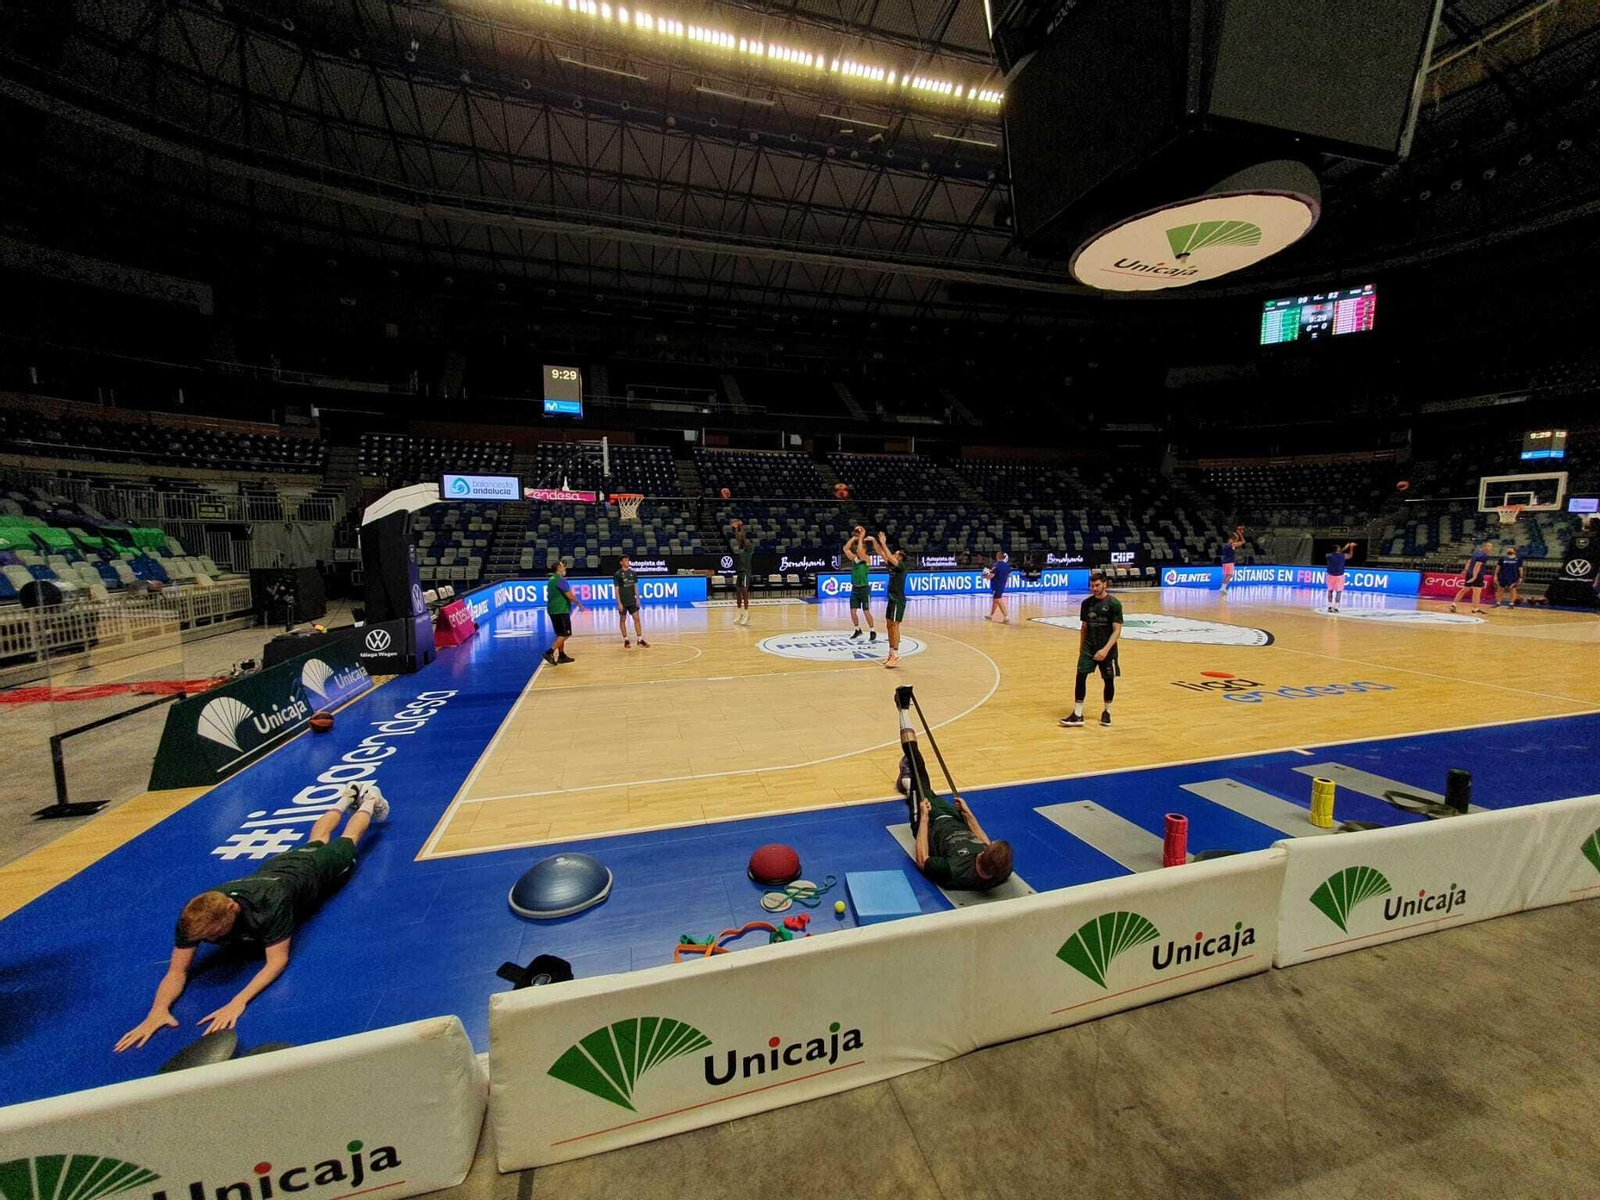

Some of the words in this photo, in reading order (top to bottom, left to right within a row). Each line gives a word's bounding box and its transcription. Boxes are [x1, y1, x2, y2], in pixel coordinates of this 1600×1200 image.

[1113, 258, 1200, 276] Unicaja
[551, 369, 577, 380] 9:29
[532, 490, 580, 501] endesa
[909, 573, 971, 592] VISÍTANOS
[976, 575, 991, 590] EN
[1277, 569, 1293, 582] EN
[333, 661, 369, 690] Unicaja
[1171, 678, 1266, 692] liga
[1222, 680, 1398, 704] endesa
[253, 695, 308, 735] Unicaja
[210, 689, 459, 861] #ligaendesa
[1382, 883, 1467, 922] Unicaja
[1152, 921, 1256, 971] Unicaja
[704, 1021, 864, 1086] Unicaja
